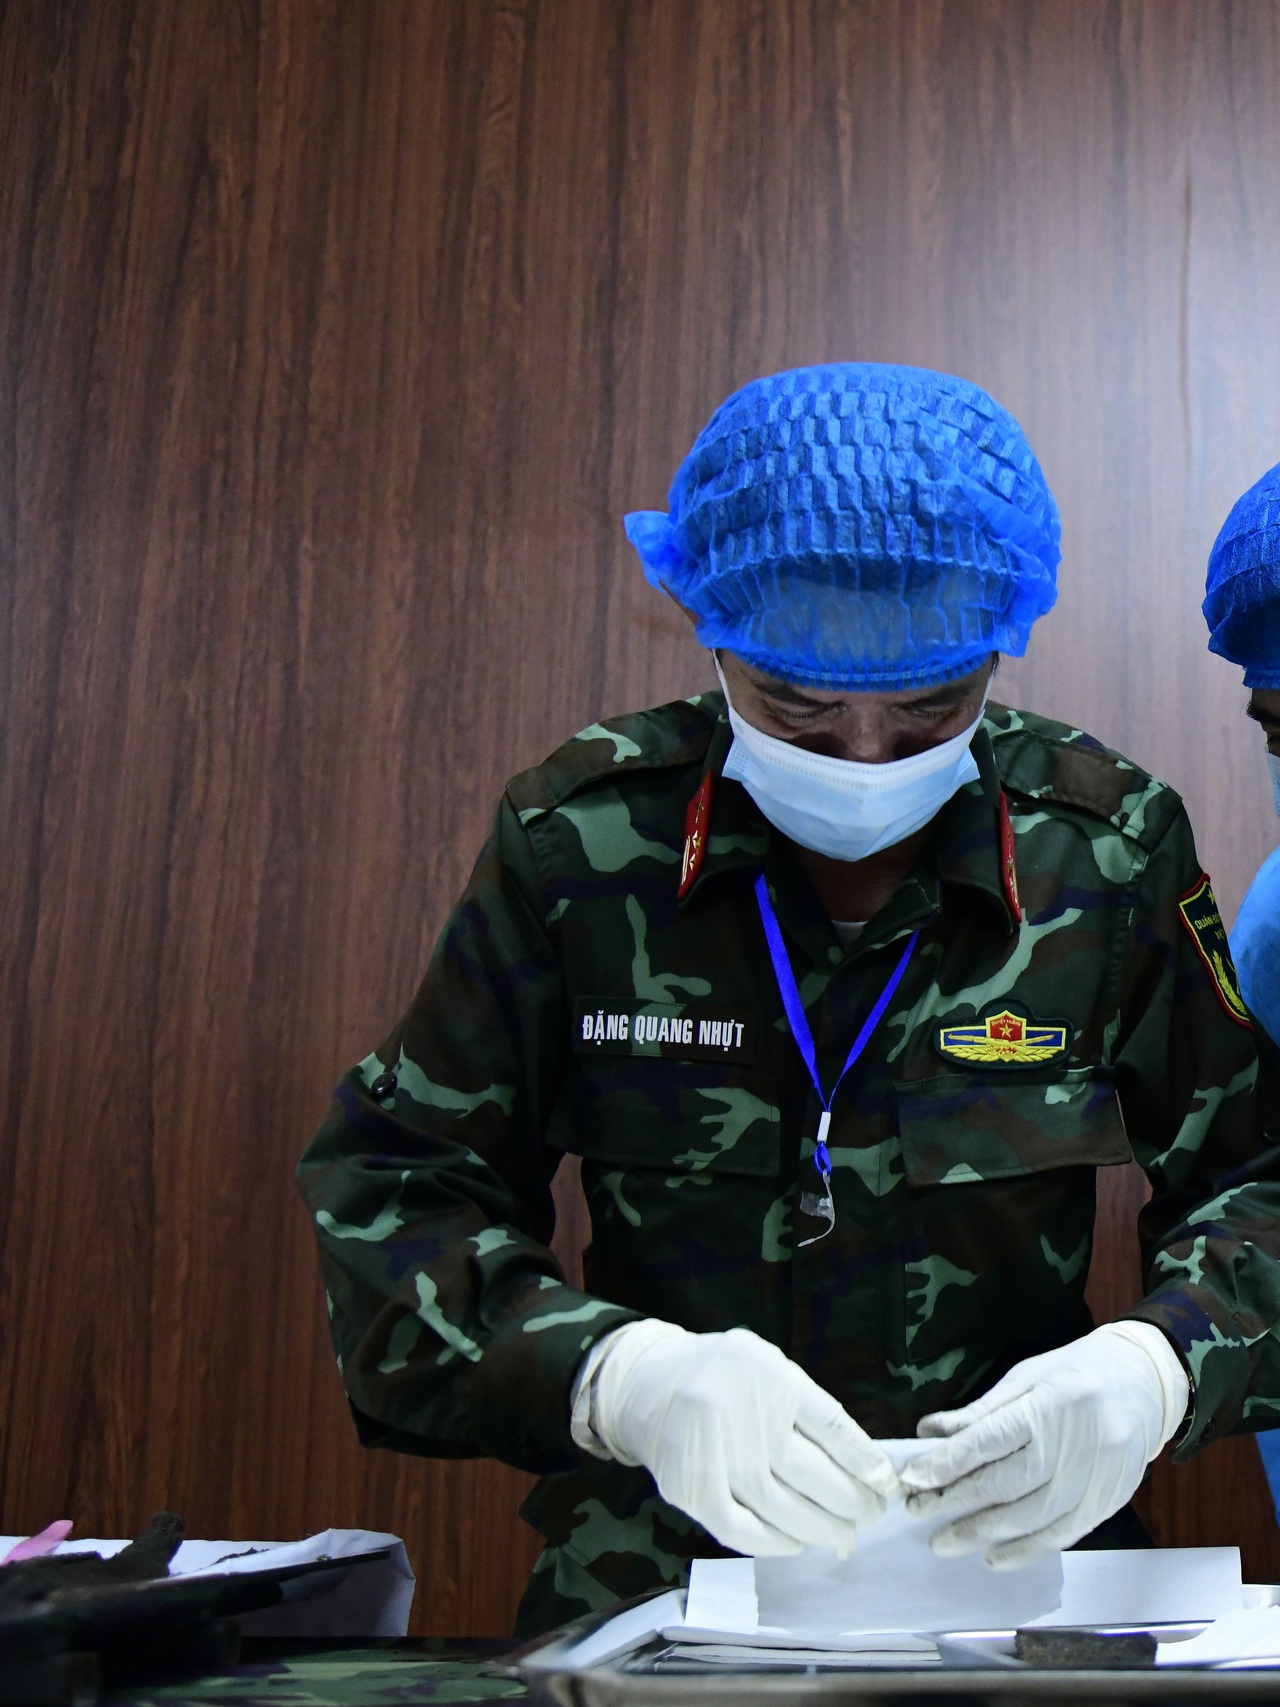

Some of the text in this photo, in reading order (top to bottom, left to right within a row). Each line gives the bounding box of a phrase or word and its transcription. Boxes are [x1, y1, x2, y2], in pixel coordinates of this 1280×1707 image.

[582, 1009, 745, 1052] ĐẶNG QUANG NHỰT
